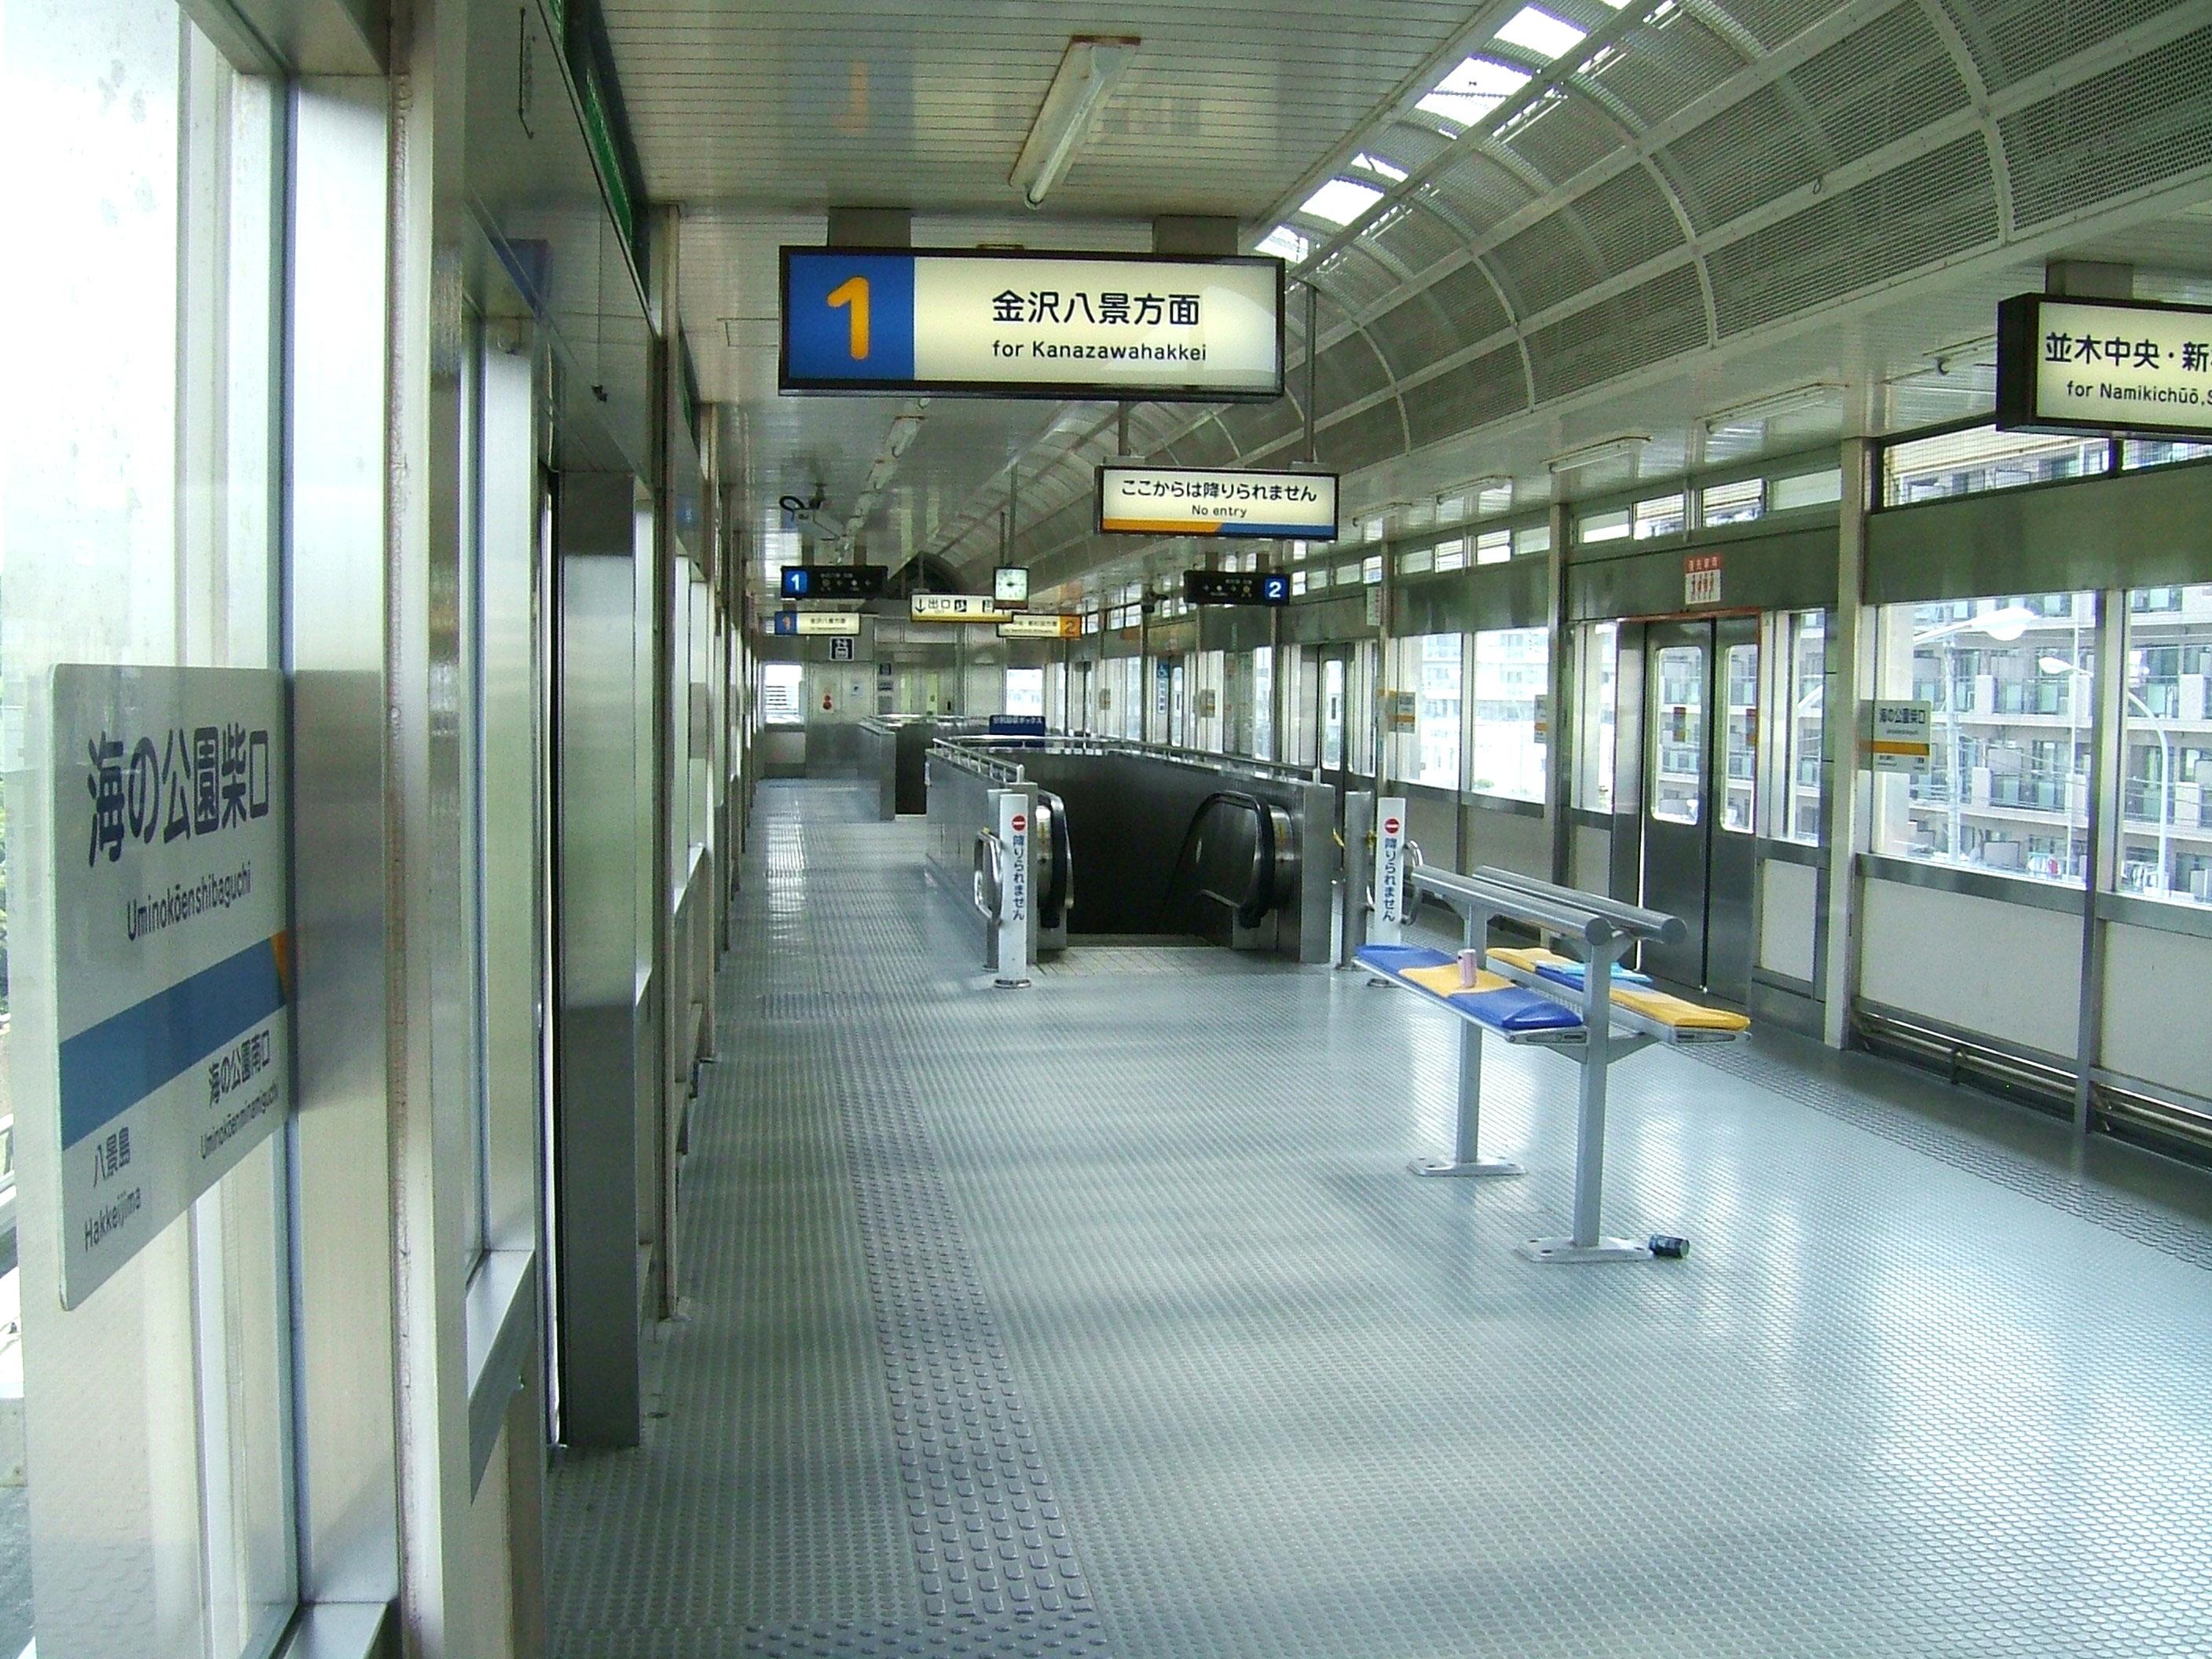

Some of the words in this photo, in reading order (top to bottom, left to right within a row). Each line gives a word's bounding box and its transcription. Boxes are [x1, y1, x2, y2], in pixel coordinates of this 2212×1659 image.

[826, 276, 870, 361] 1
[992, 290, 1200, 327] 金沢八景方面
[992, 340, 1024, 359] for
[1032, 340, 1207, 362] Kanazawahakkei
[2045, 331, 2212, 373] 並木中央・新
[2067, 380, 2093, 398] for
[1122, 478, 1318, 504] ここからは降りられません
[1192, 504, 1210, 517] No
[1213, 506, 1247, 519] entry
[790, 573, 800, 591] 1
[1269, 581, 1281, 598] 2
[928, 598, 951, 610] 出口
[87, 721, 269, 868] 海の公園柴口
[1012, 835, 1024, 921] 降りられません
[1382, 837, 1397, 922] 降りられません
[126, 860, 251, 942] Uminokōenshibaguchi
[93, 1126, 131, 1188] 八景島
[83, 1185, 141, 1251] Hakkeijima
